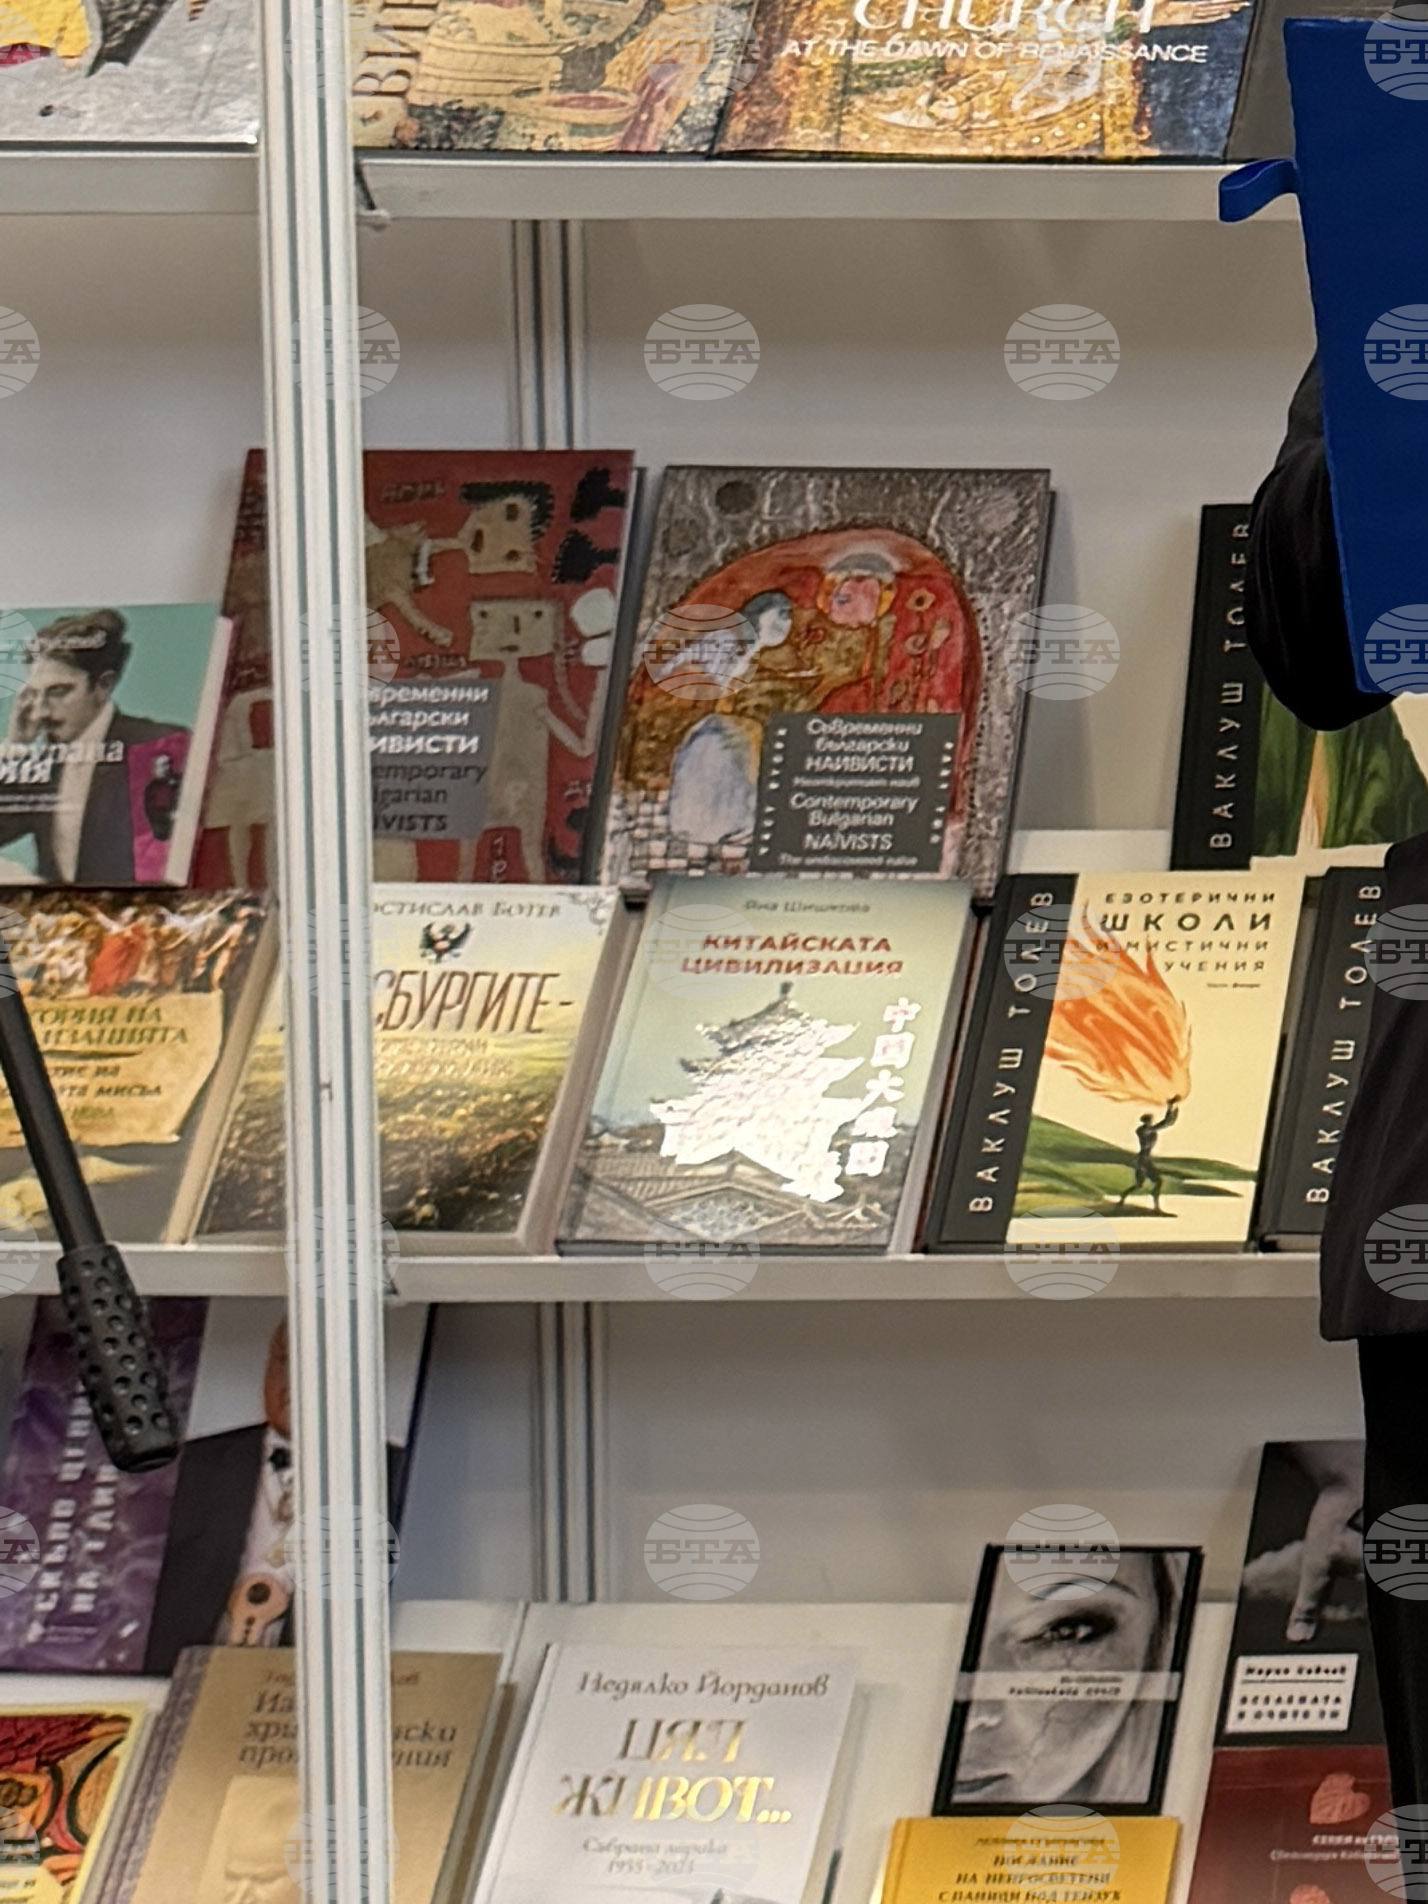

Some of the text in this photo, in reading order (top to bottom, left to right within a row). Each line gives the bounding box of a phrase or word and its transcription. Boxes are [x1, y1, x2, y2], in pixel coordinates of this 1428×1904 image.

[780, 40, 819, 58] AT
[828, 40, 878, 58] THE
[887, 41, 969, 59] DAWN
[974, 42, 1015, 59] OF
[1099, 913, 1272, 932] ШКОЛИ
[702, 933, 892, 953] КИТАЙСКАТА
[680, 957, 904, 976] ЦИВИЛИЗАЦИЯ
[968, 892, 1053, 1212] ВАКЛУШ ТОЛЕВ
